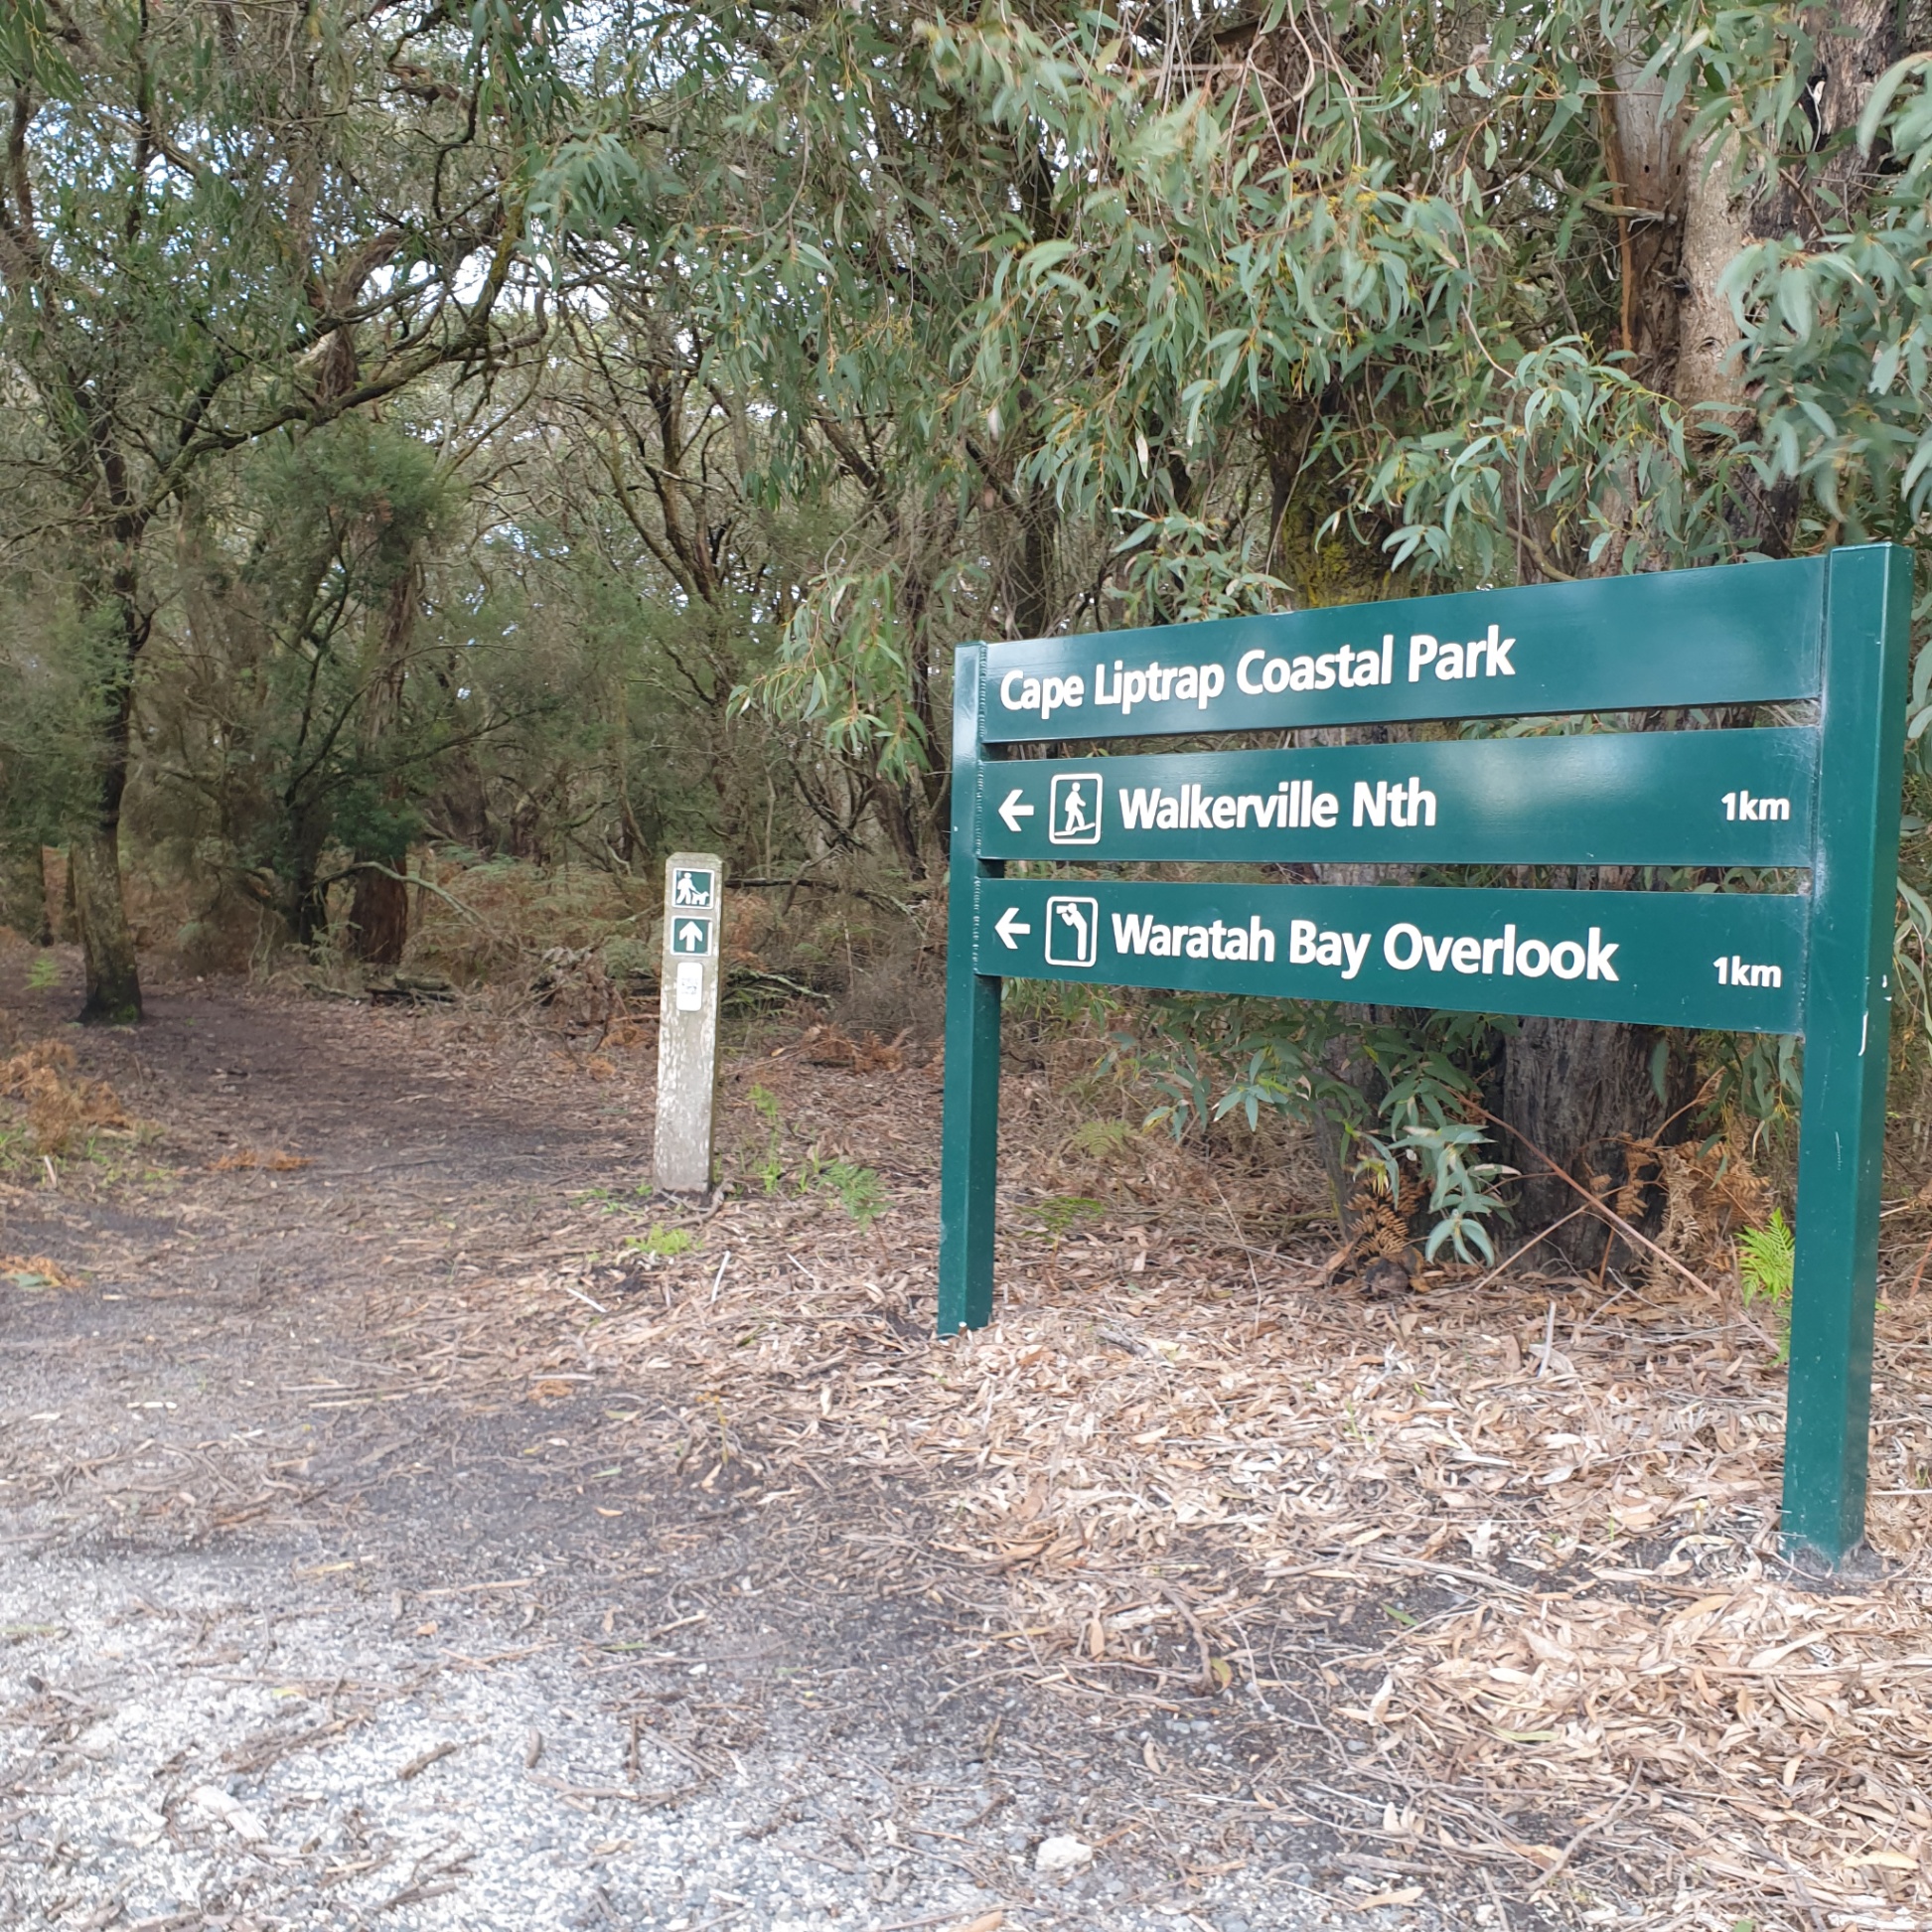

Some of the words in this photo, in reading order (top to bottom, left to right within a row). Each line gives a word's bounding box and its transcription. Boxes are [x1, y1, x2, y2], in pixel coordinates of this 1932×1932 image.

[999, 669, 1084, 719] Cape
[1094, 660, 1225, 714] Liptrap
[1236, 634, 1394, 695] Coastal
[1407, 624, 1517, 683] Park
[1118, 780, 1339, 830] Walkerville
[1351, 777, 1437, 827] Nth
[1721, 790, 1790, 821] 1km
[1111, 912, 1275, 963] Waratah
[1288, 919, 1372, 980] Bay
[1383, 923, 1619, 982] Overlook
[1712, 956, 1782, 988] 1km
